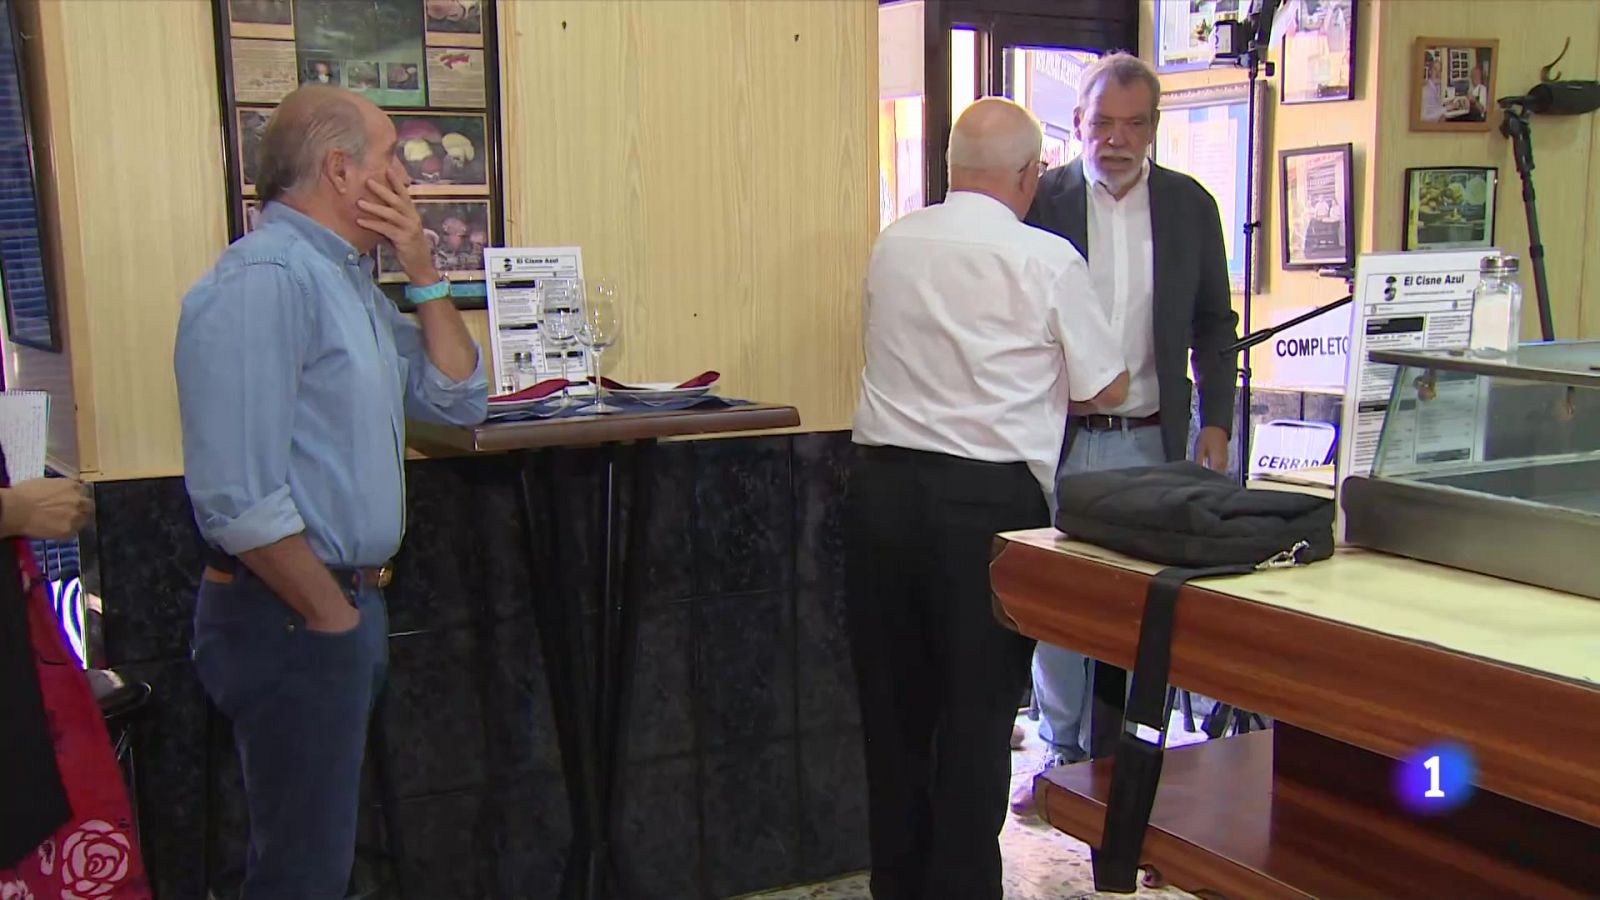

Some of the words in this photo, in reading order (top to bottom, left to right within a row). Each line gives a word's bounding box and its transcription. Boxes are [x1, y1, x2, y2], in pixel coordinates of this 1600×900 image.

[1404, 276, 1413, 286] El
[1416, 275, 1442, 286] Cisne
[1444, 274, 1465, 285] Azul
[1258, 455, 1321, 470] CERRAD
